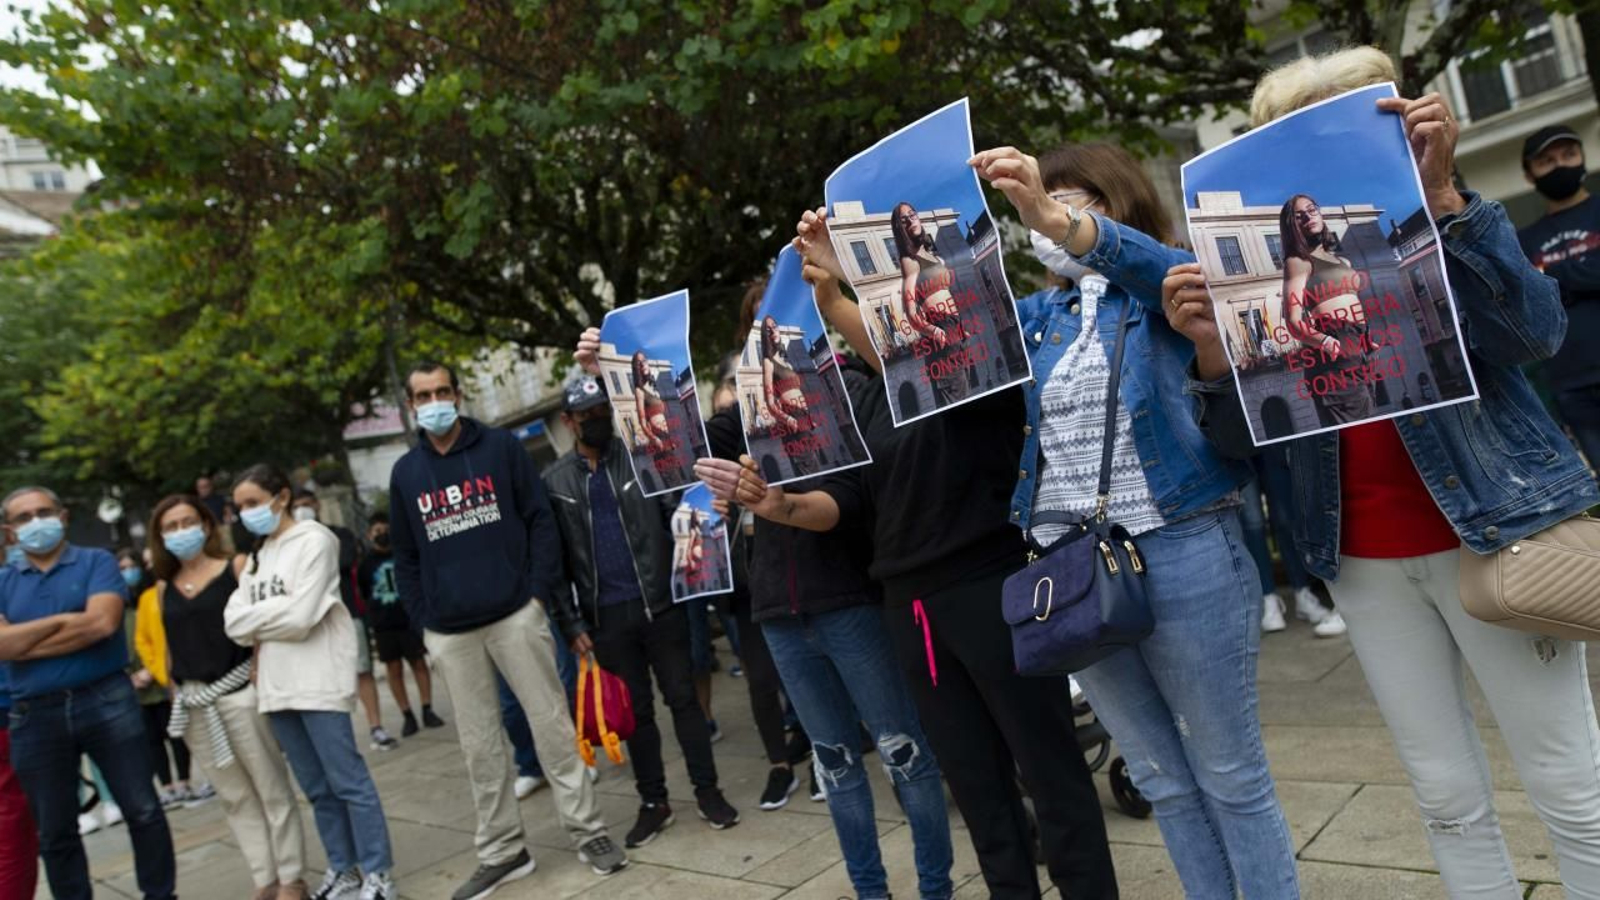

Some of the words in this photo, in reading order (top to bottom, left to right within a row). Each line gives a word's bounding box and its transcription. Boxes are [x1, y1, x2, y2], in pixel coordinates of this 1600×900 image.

[1288, 271, 1369, 308] ANIMO
[1273, 292, 1401, 345] GUERRERA
[1285, 324, 1405, 374] ESTAMOS
[1297, 356, 1406, 400] CONTIGO
[417, 475, 494, 513] URBAN
